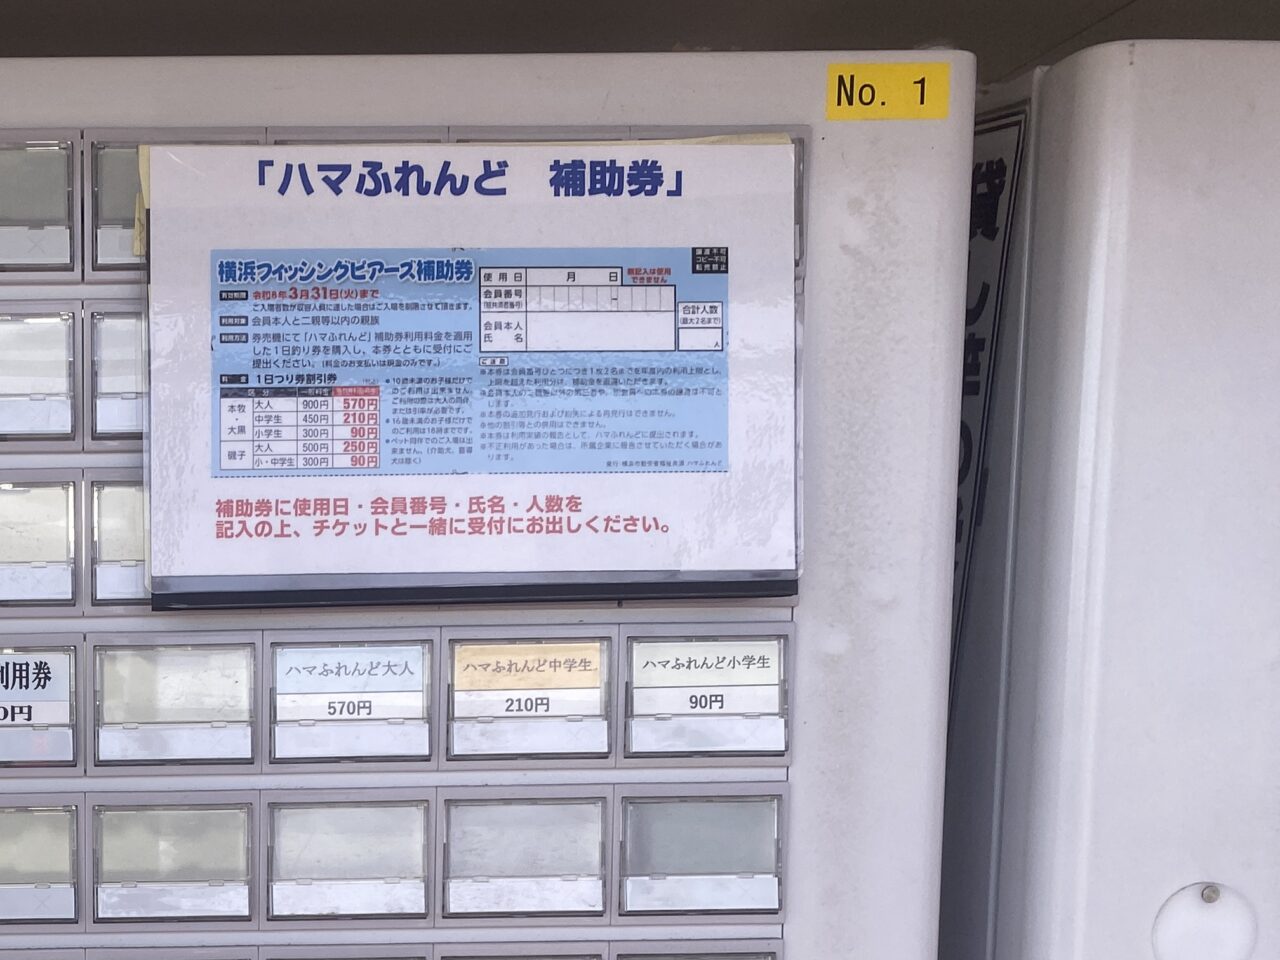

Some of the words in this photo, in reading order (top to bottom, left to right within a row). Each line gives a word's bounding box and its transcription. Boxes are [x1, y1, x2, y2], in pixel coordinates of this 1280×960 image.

[836, 73, 886, 108] No.
[912, 76, 927, 106] 1
[257, 159, 509, 198] 「ハマふれんど
[548, 158, 684, 198] 補助券」
[218, 258, 474, 284] 横浜フィッシングピアーズ補助券
[483, 271, 523, 283] 使用日
[483, 289, 523, 299] 会員番号
[682, 305, 719, 315] 合計人数
[251, 315, 380, 326] 会員本人と二親等以内の親族
[483, 321, 524, 332] 会員本人
[256, 373, 337, 384] 1日つり券割引券
[227, 404, 247, 414] 本牧
[254, 400, 274, 410] 大人
[302, 400, 329, 410] 900円
[342, 398, 378, 411] 570円
[254, 414, 283, 424] 中学生
[302, 414, 329, 424] 450円
[342, 412, 378, 425] 210円
[227, 425, 247, 435] 大黒
[254, 429, 283, 439] 小学生
[302, 428, 329, 438] 300円
[350, 426, 378, 439] 90円
[254, 443, 273, 453] 大人
[302, 442, 329, 453] 500円
[342, 441, 378, 453] 250円
[254, 457, 295, 467] 小・中学生
[302, 457, 329, 467] 300円
[350, 455, 378, 468] 90円
[215, 494, 583, 519] 補助券に使用日・会員番号・氏名・人数を
[215, 514, 672, 540] 記入の上、チケットと一緒に受付にお出しください。
[285, 659, 416, 679] ハマふれんど大人
[463, 657, 594, 676] ハマふれんど中学生
[642, 654, 772, 673] ハマふれんど小学生
[327, 699, 373, 717] 570円
[504, 697, 551, 714] 210円
[689, 693, 725, 711] 90円
